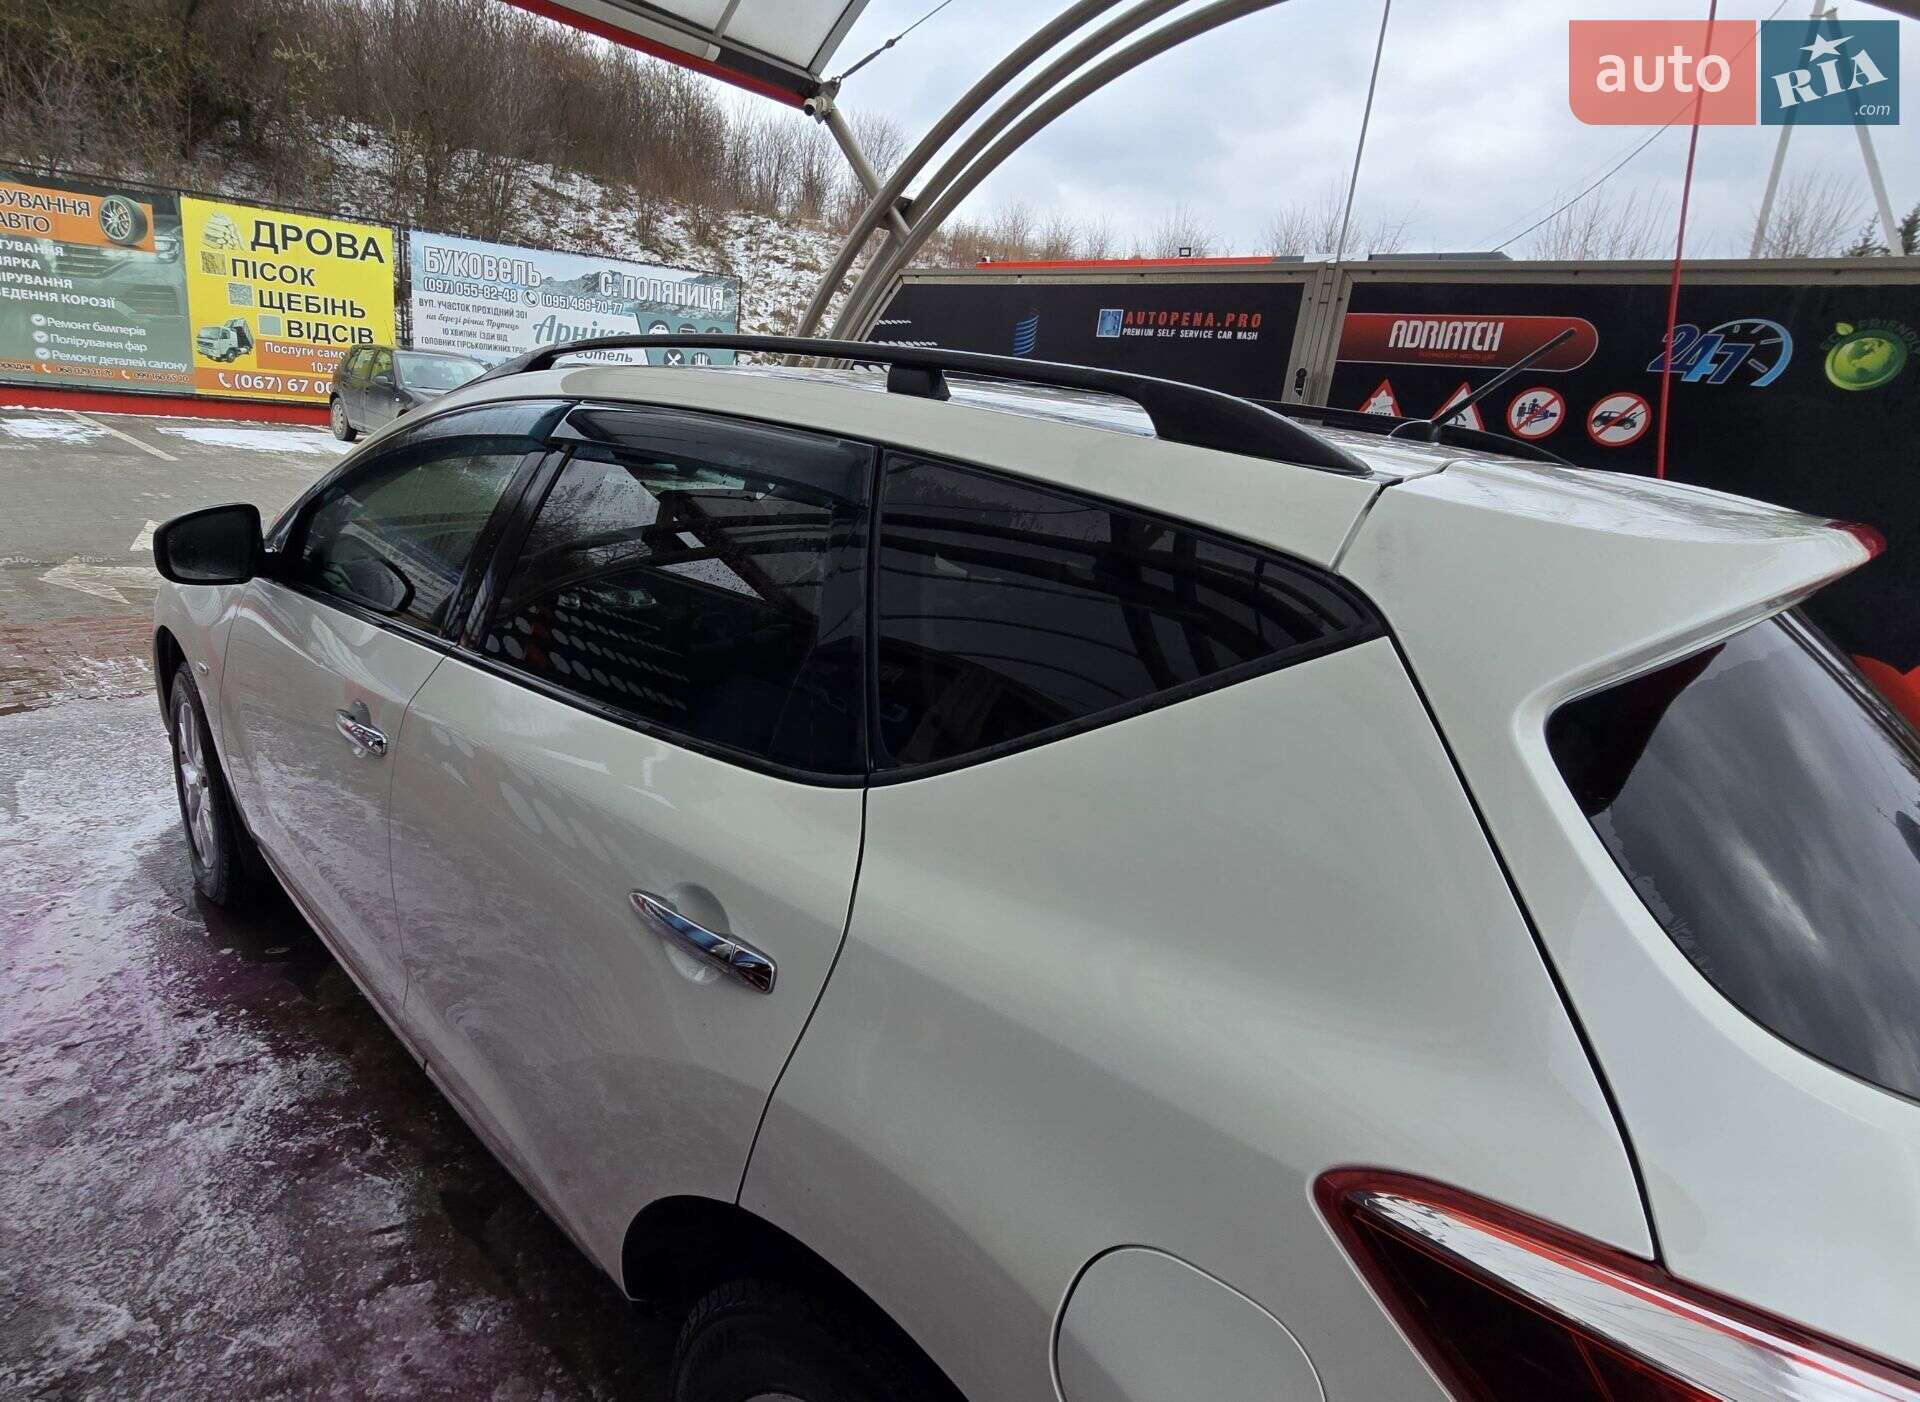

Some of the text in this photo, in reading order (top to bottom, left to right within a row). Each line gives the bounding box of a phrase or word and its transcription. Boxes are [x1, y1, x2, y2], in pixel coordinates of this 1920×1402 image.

[251, 220, 385, 263] ДРОВА
[0, 256, 41, 270] ЯРКА
[231, 258, 315, 286] ПІСОК
[0, 271, 73, 289] ІРУВАННЯ
[424, 277, 517, 303] (097) 055-82-48
[0, 287, 116, 309] ЕДЕННЯ КОРОЗІЇ
[622, 275, 724, 312] ПОЛЯНИЦЯ
[258, 290, 366, 319] ЩЕБІНЬ
[47, 317, 146, 337] Ремонт бамперів
[1124, 311, 1262, 328] AUTOPENA.PRO
[287, 319, 374, 344] ВІДСІВ
[1122, 327, 1259, 341] PREMIUM SELF SERVICE CAR WASH
[51, 334, 148, 353] Полірування фар
[265, 341, 314, 359] Послуги
[52, 350, 188, 373] Ремонт деталей салону
[234, 374, 282, 393] (067)
[287, 379, 308, 394] 67
